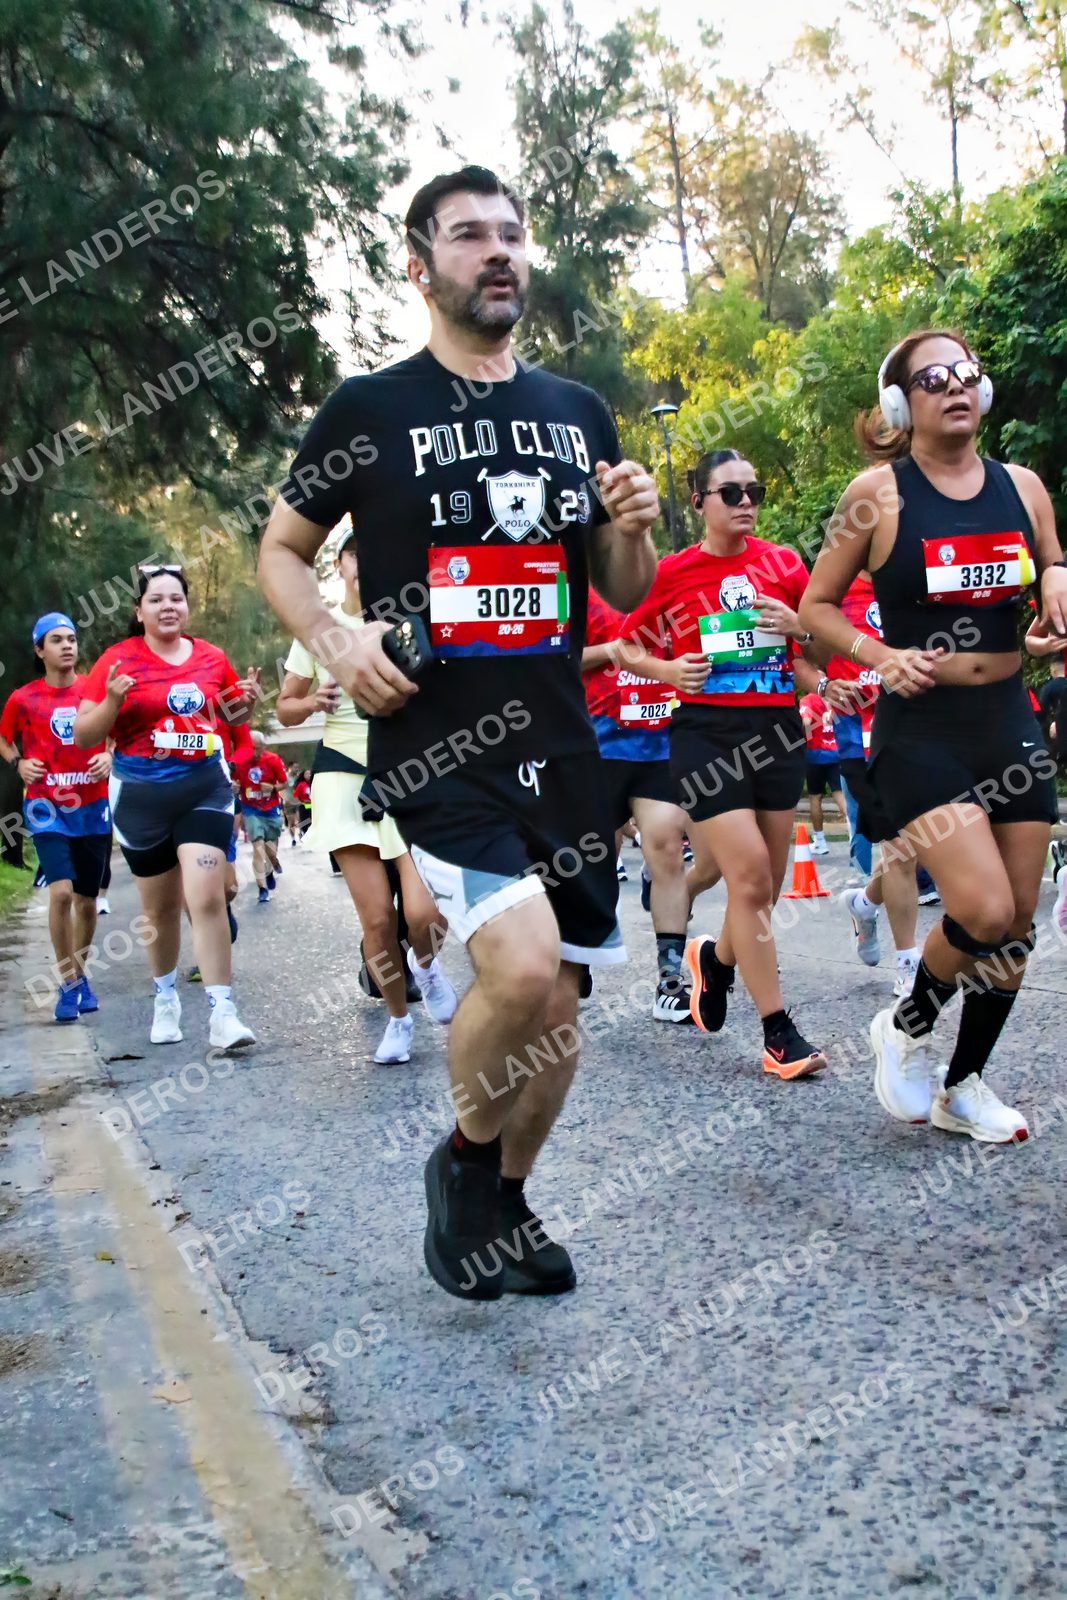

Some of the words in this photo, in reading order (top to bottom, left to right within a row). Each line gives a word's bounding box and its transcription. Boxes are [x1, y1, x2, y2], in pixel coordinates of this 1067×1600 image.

[409, 420, 498, 477] POLO
[511, 420, 591, 474] CLUB
[430, 491, 472, 527] 19
[560, 489, 591, 524] 23
[505, 520, 530, 528] POLO
[961, 564, 1006, 588] 3332
[477, 586, 541, 618] 3028
[498, 624, 524, 635] 20-26
[736, 631, 754, 648] 53
[641, 703, 667, 718] 2022
[177, 734, 203, 748] 1828
